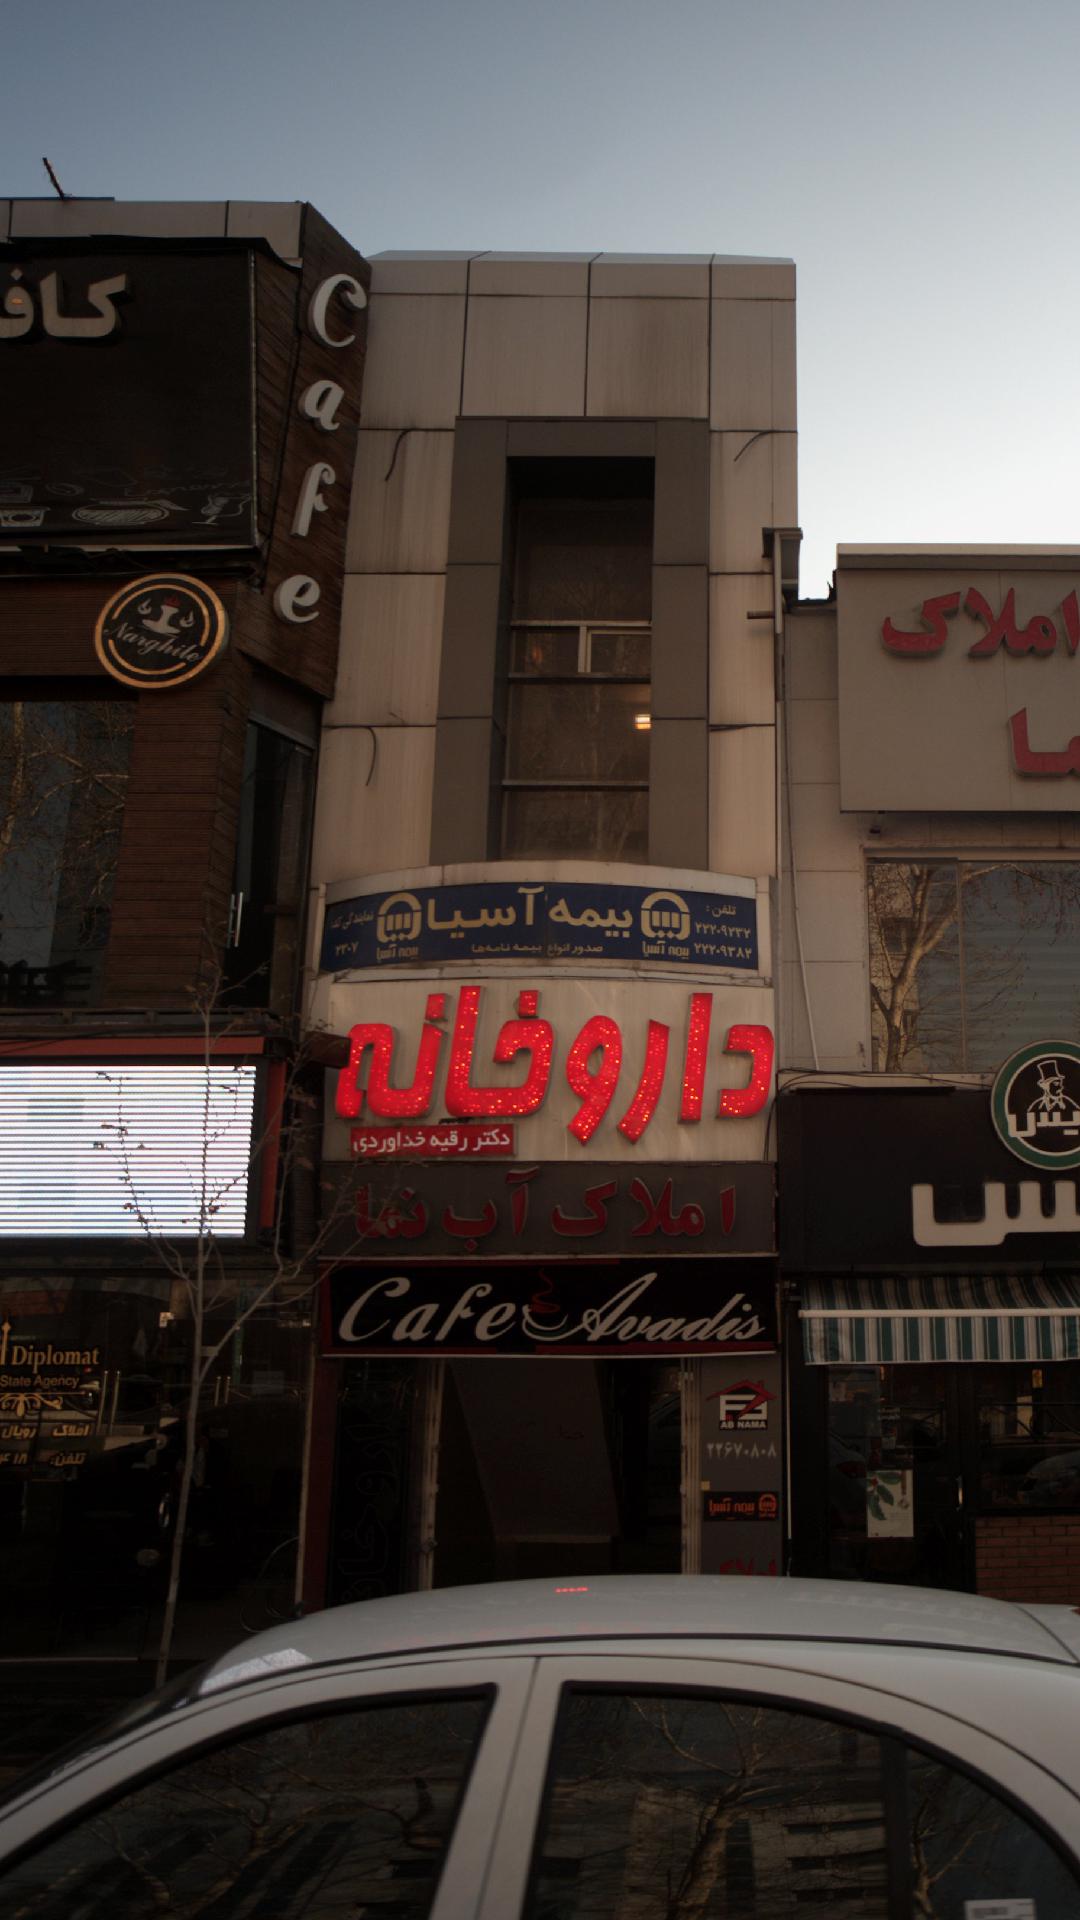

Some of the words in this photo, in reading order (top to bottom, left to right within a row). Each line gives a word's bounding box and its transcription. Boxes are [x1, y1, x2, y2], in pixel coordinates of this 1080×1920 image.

[274, 272, 368, 625] Cafe
[104, 622, 203, 662] Narghile
[882, 586, 1080, 660] املاک
[426, 885, 545, 939] آسیا
[548, 896, 633, 938] بیمه
[573, 943, 604, 955] صدور
[335, 985, 775, 1145] داروخانه
[353, 1130, 427, 1153] خداوردی
[430, 1130, 469, 1152] رقیه
[473, 1128, 511, 1152] دکتر
[354, 1180, 428, 1240] نما
[441, 1167, 539, 1252] آب
[550, 1176, 738, 1238] املاک
[339, 1275, 518, 1345] Cafe
[581, 1271, 768, 1344] Avadis
[11, 1344, 101, 1374] Diplomat
[0, 1374, 32, 1388] State
[33, 1374, 80, 1390] Agency
[51, 1424, 91, 1438] املاک
[737, 1421, 767, 1429] NAMA
